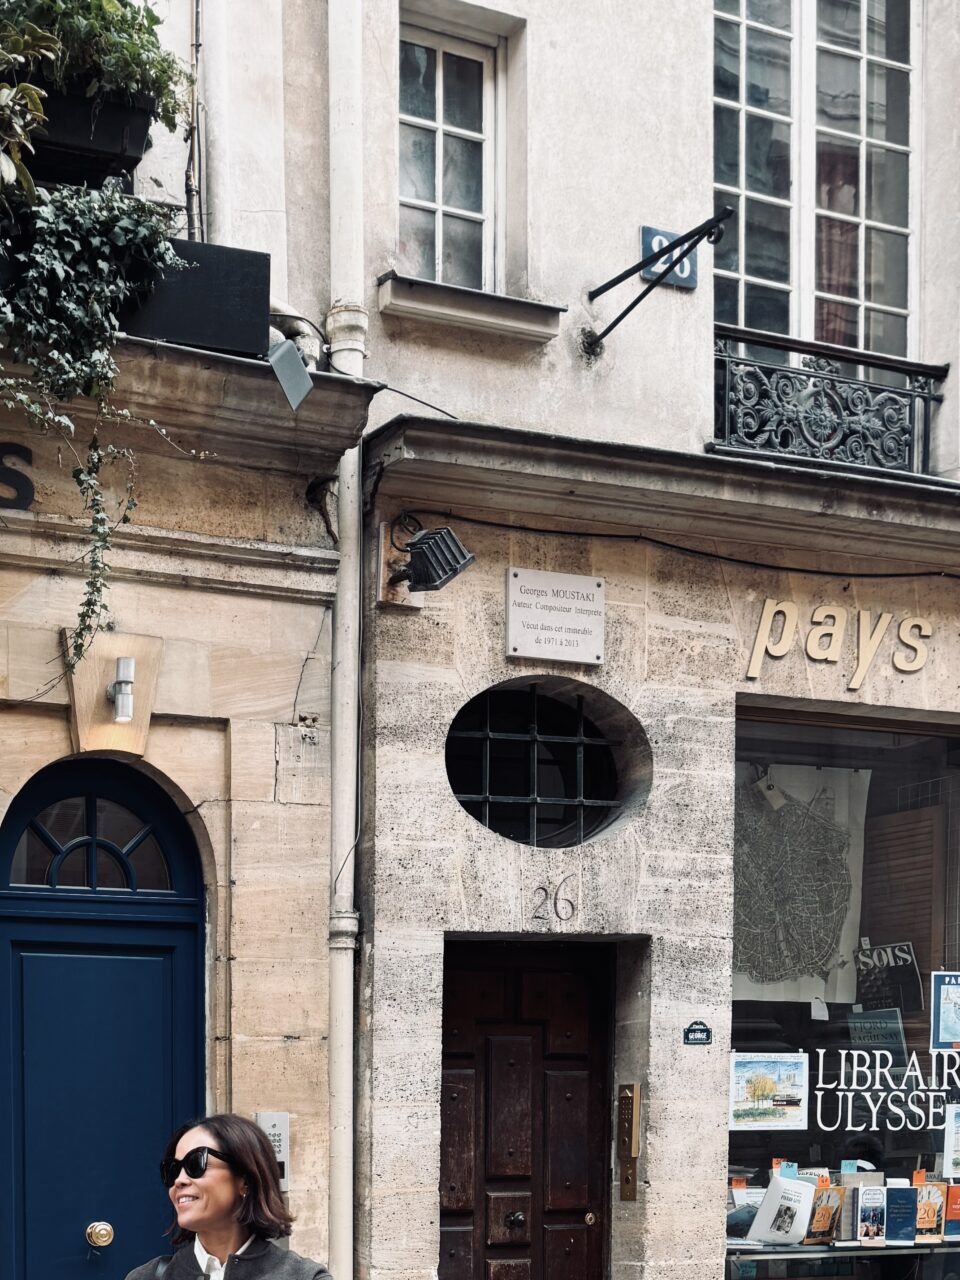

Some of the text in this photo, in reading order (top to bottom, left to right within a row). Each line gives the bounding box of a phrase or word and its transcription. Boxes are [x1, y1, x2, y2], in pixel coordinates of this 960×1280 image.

[650, 235, 691, 279] 26
[511, 599, 532, 609] Auteur
[535, 601, 572, 614] Compositeur
[519, 585, 595, 603] Georges MOUSTAKI
[521, 620, 593, 636] Vécut dans cet immeuble
[534, 636, 542, 645] de
[543, 637, 557, 646] 1971
[565, 639, 579, 648] 2013
[746, 597, 934, 691] pays
[530, 873, 577, 922] 26
[815, 1048, 960, 1090] LIBRAIR
[814, 1091, 947, 1132] ULYSSE
[919, 1206, 936, 1220] 20
